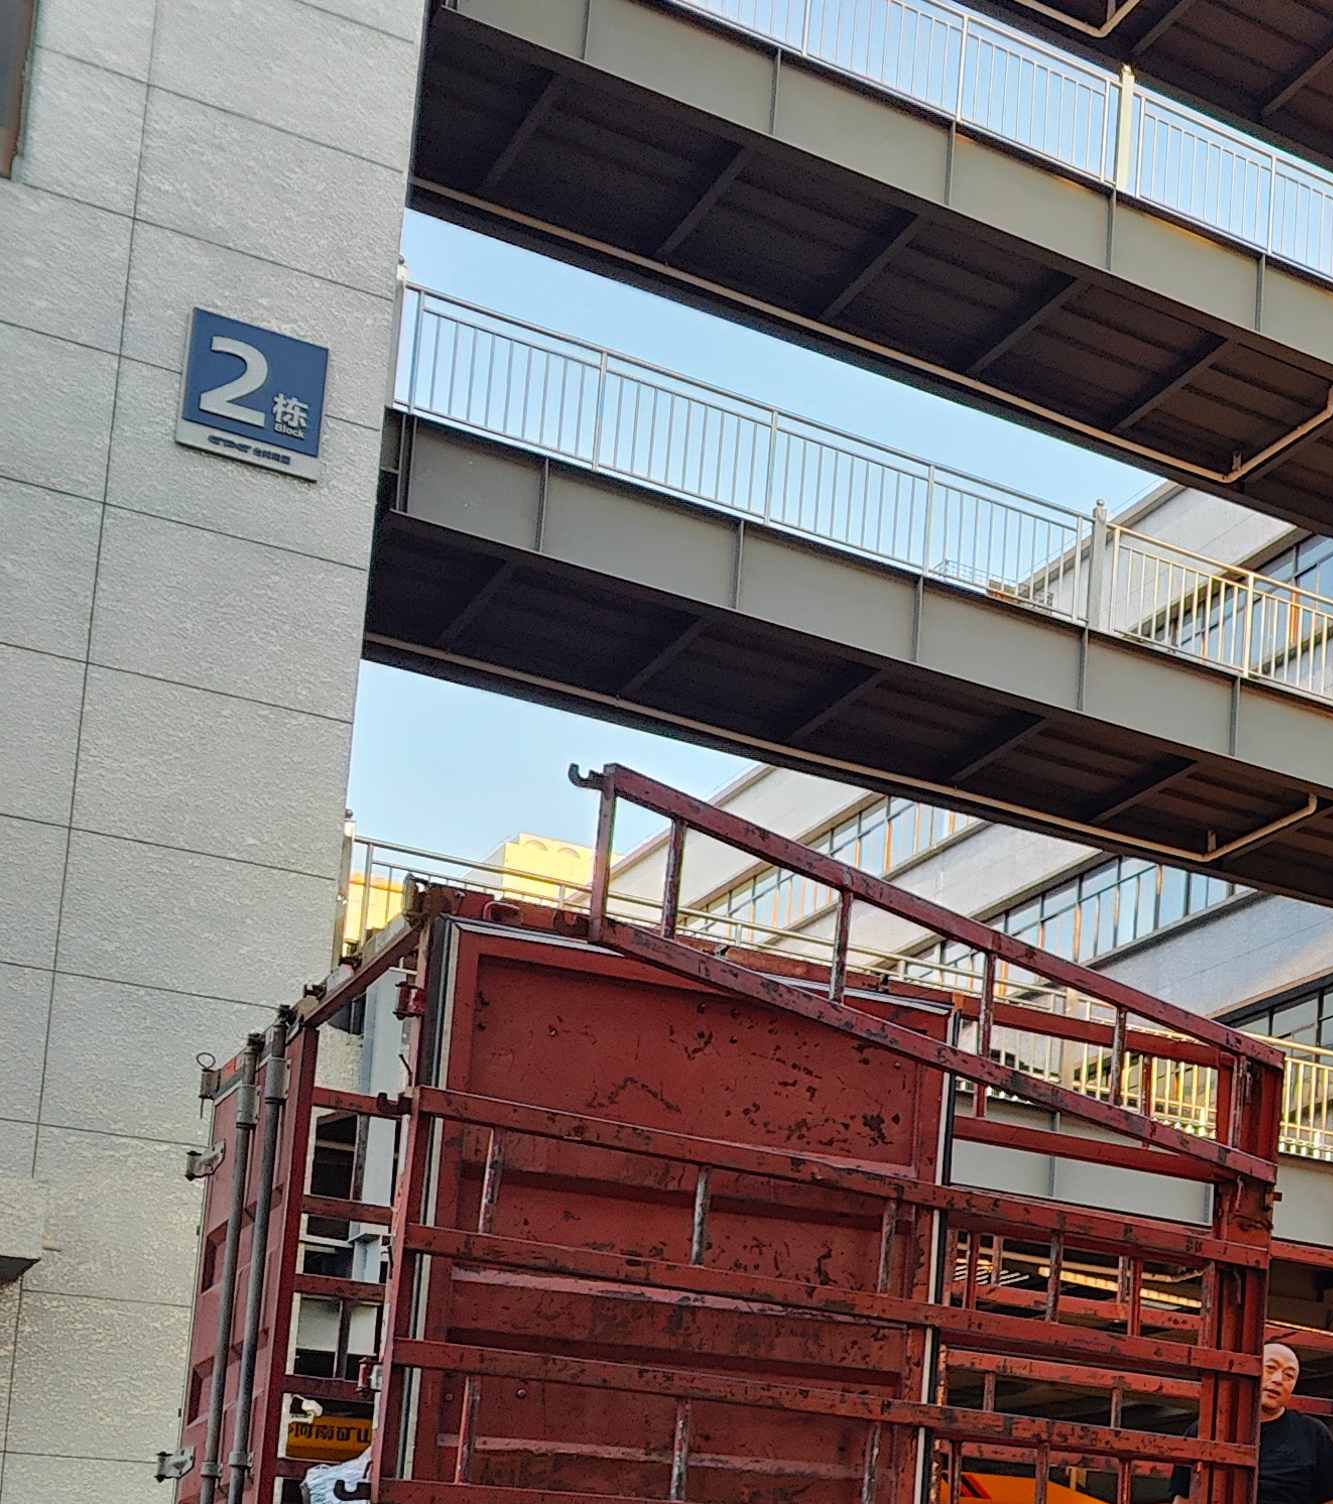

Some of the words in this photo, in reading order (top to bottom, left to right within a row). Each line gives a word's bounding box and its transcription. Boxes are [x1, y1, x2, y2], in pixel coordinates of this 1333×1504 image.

[199, 335, 268, 428] 2
[272, 392, 309, 428] 栋
[274, 422, 305, 439] Block
